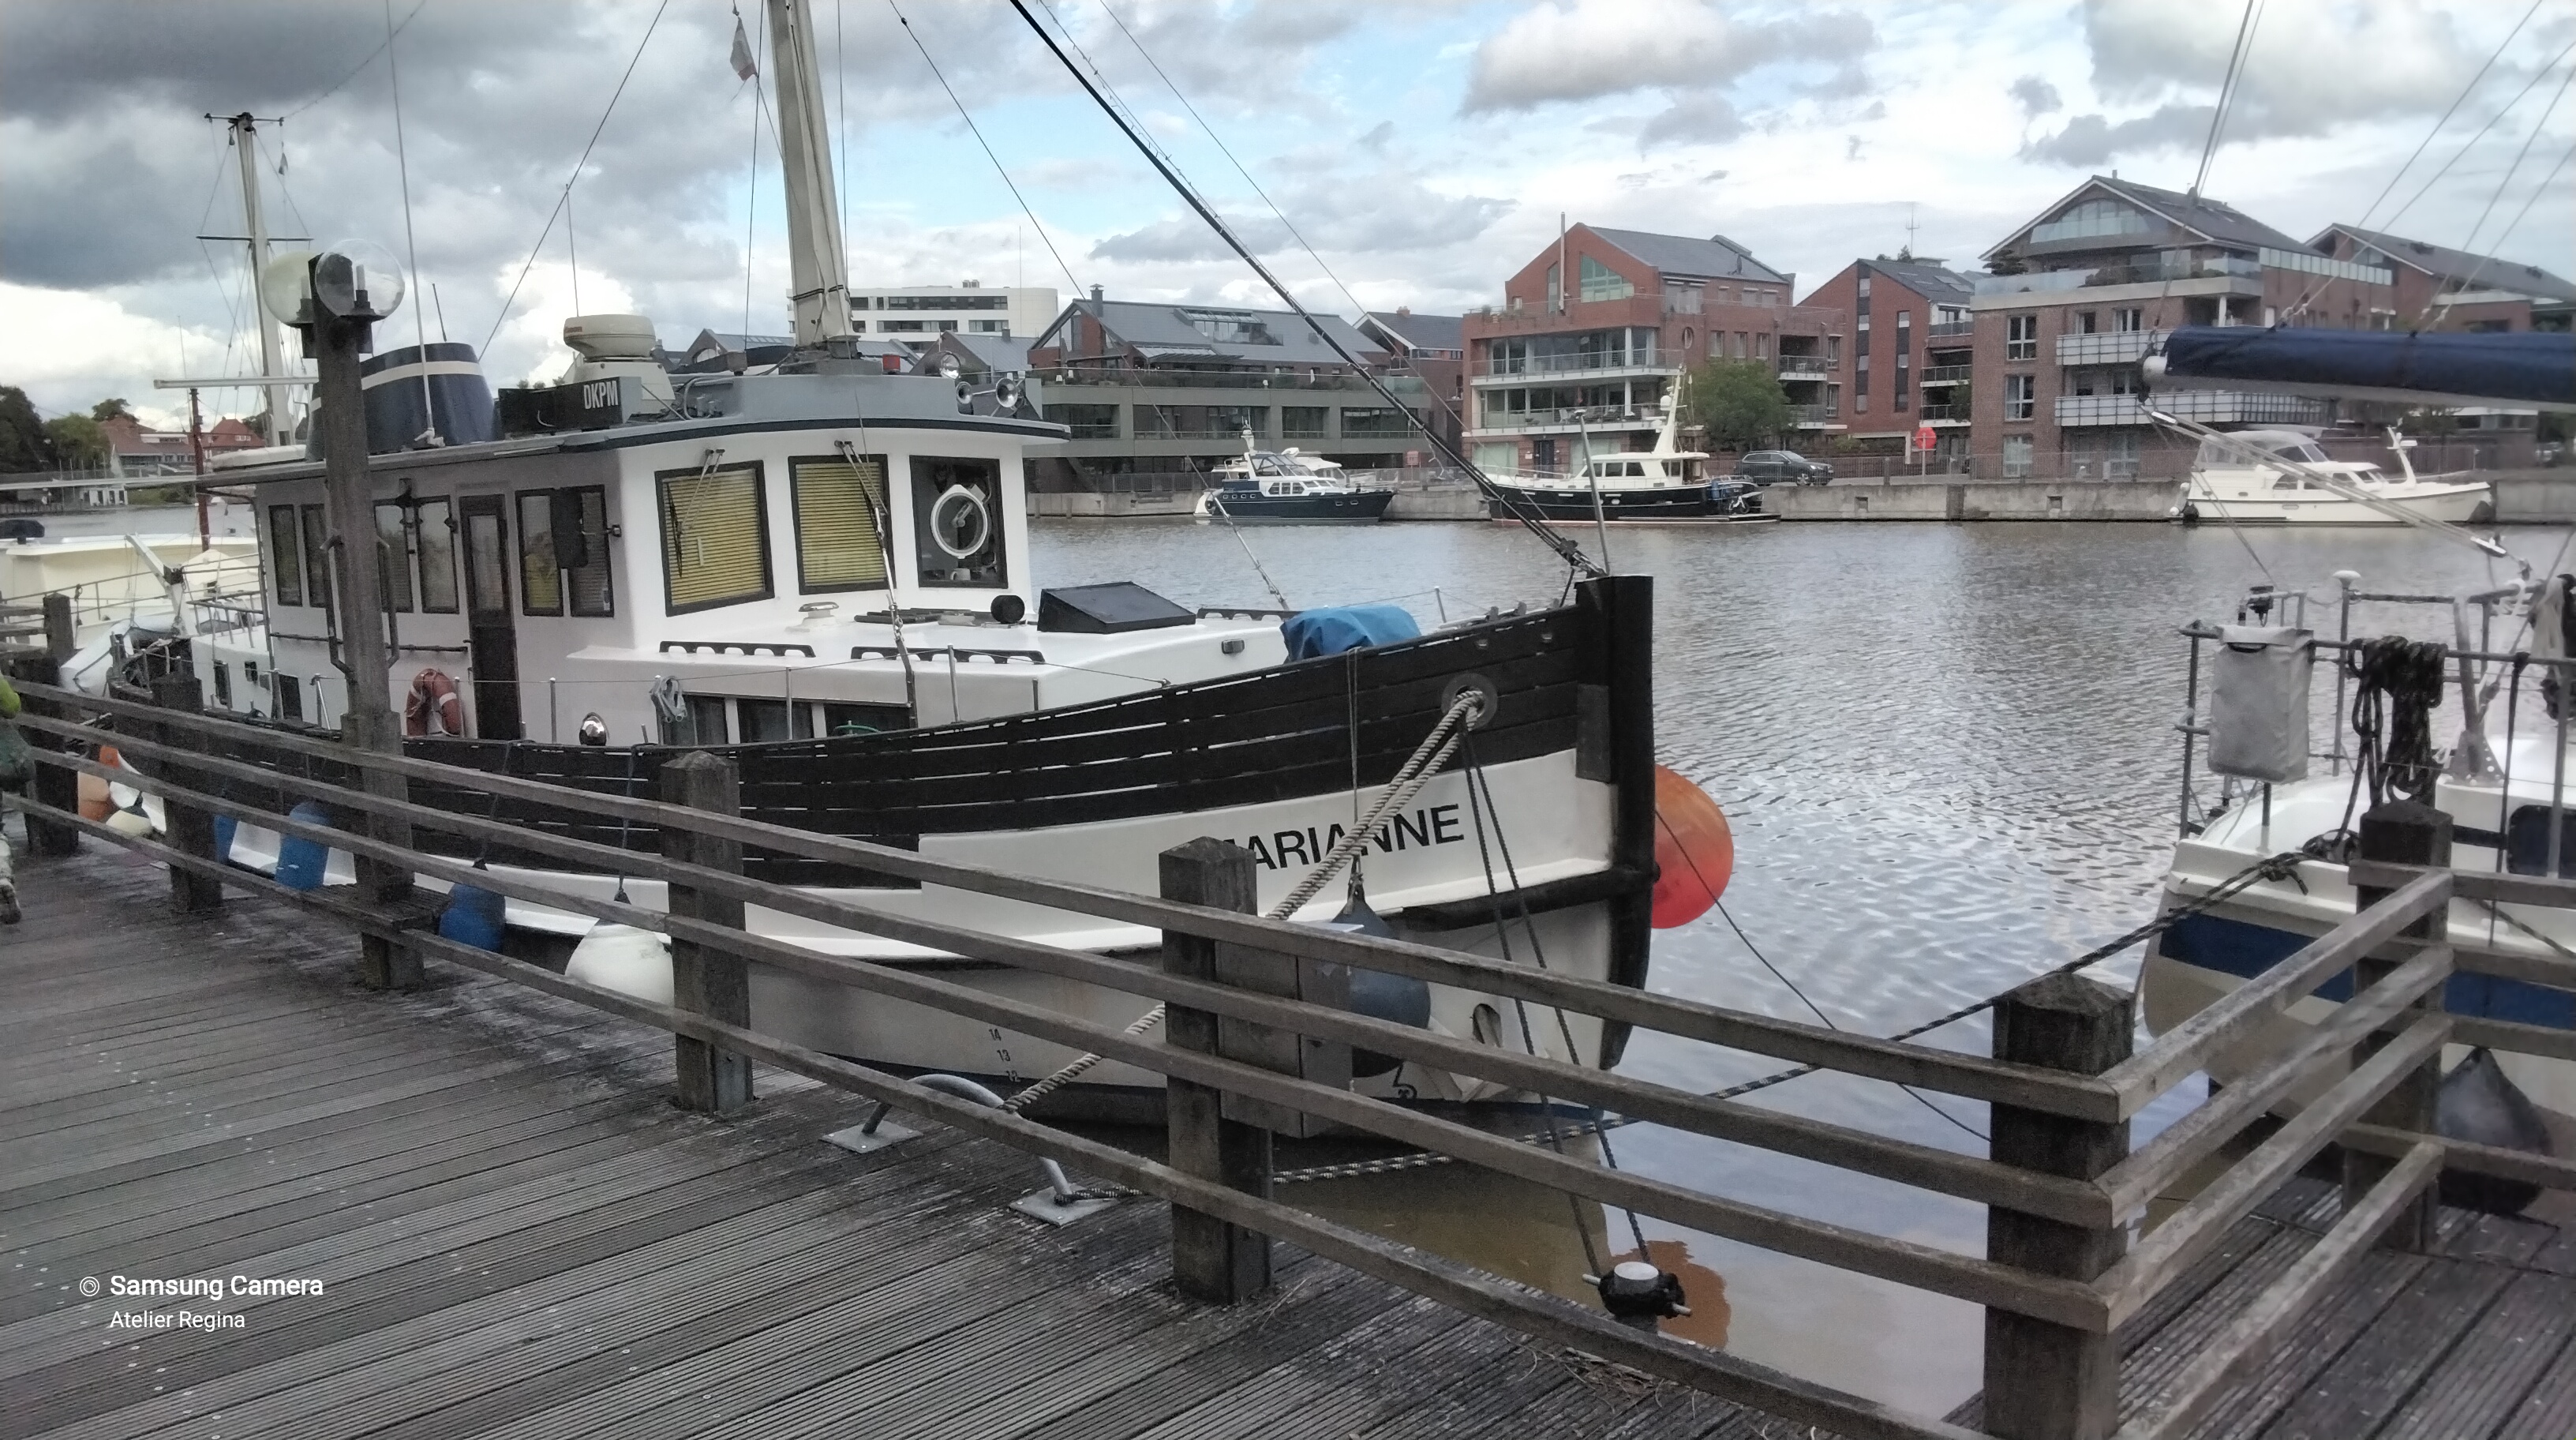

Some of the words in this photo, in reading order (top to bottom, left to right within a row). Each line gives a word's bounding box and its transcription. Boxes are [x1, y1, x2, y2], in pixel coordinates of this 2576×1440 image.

[583, 381, 618, 410] DKPM
[1223, 804, 1465, 870] ARIANNE
[988, 1029, 1002, 1041] 14
[996, 1049, 1011, 1062] 13
[1005, 1070, 1021, 1082] 12
